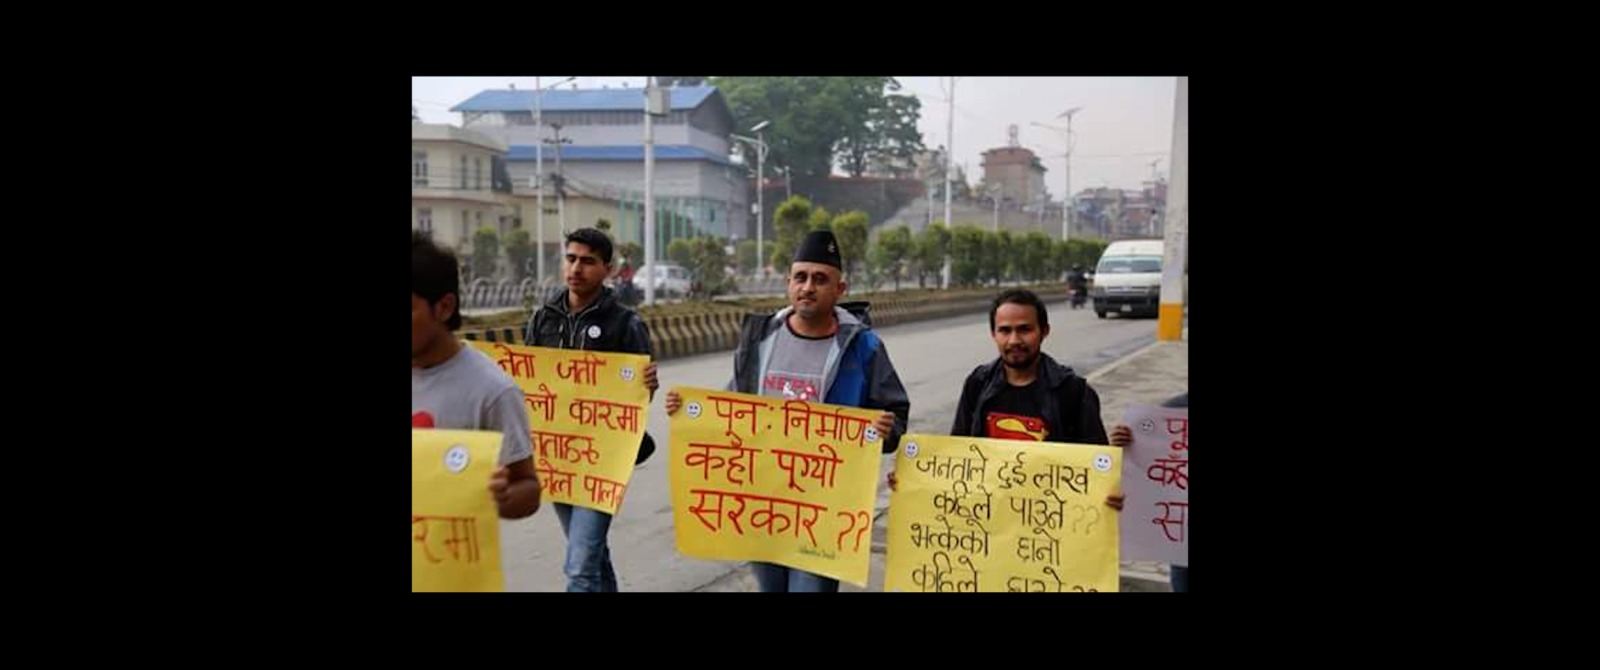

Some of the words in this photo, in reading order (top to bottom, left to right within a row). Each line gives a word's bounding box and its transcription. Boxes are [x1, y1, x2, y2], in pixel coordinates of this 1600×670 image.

[569, 397, 642, 433] कारमा
[916, 443, 989, 483] जनताले
[1033, 463, 1091, 495] लाख
[689, 489, 828, 547] सरकार
